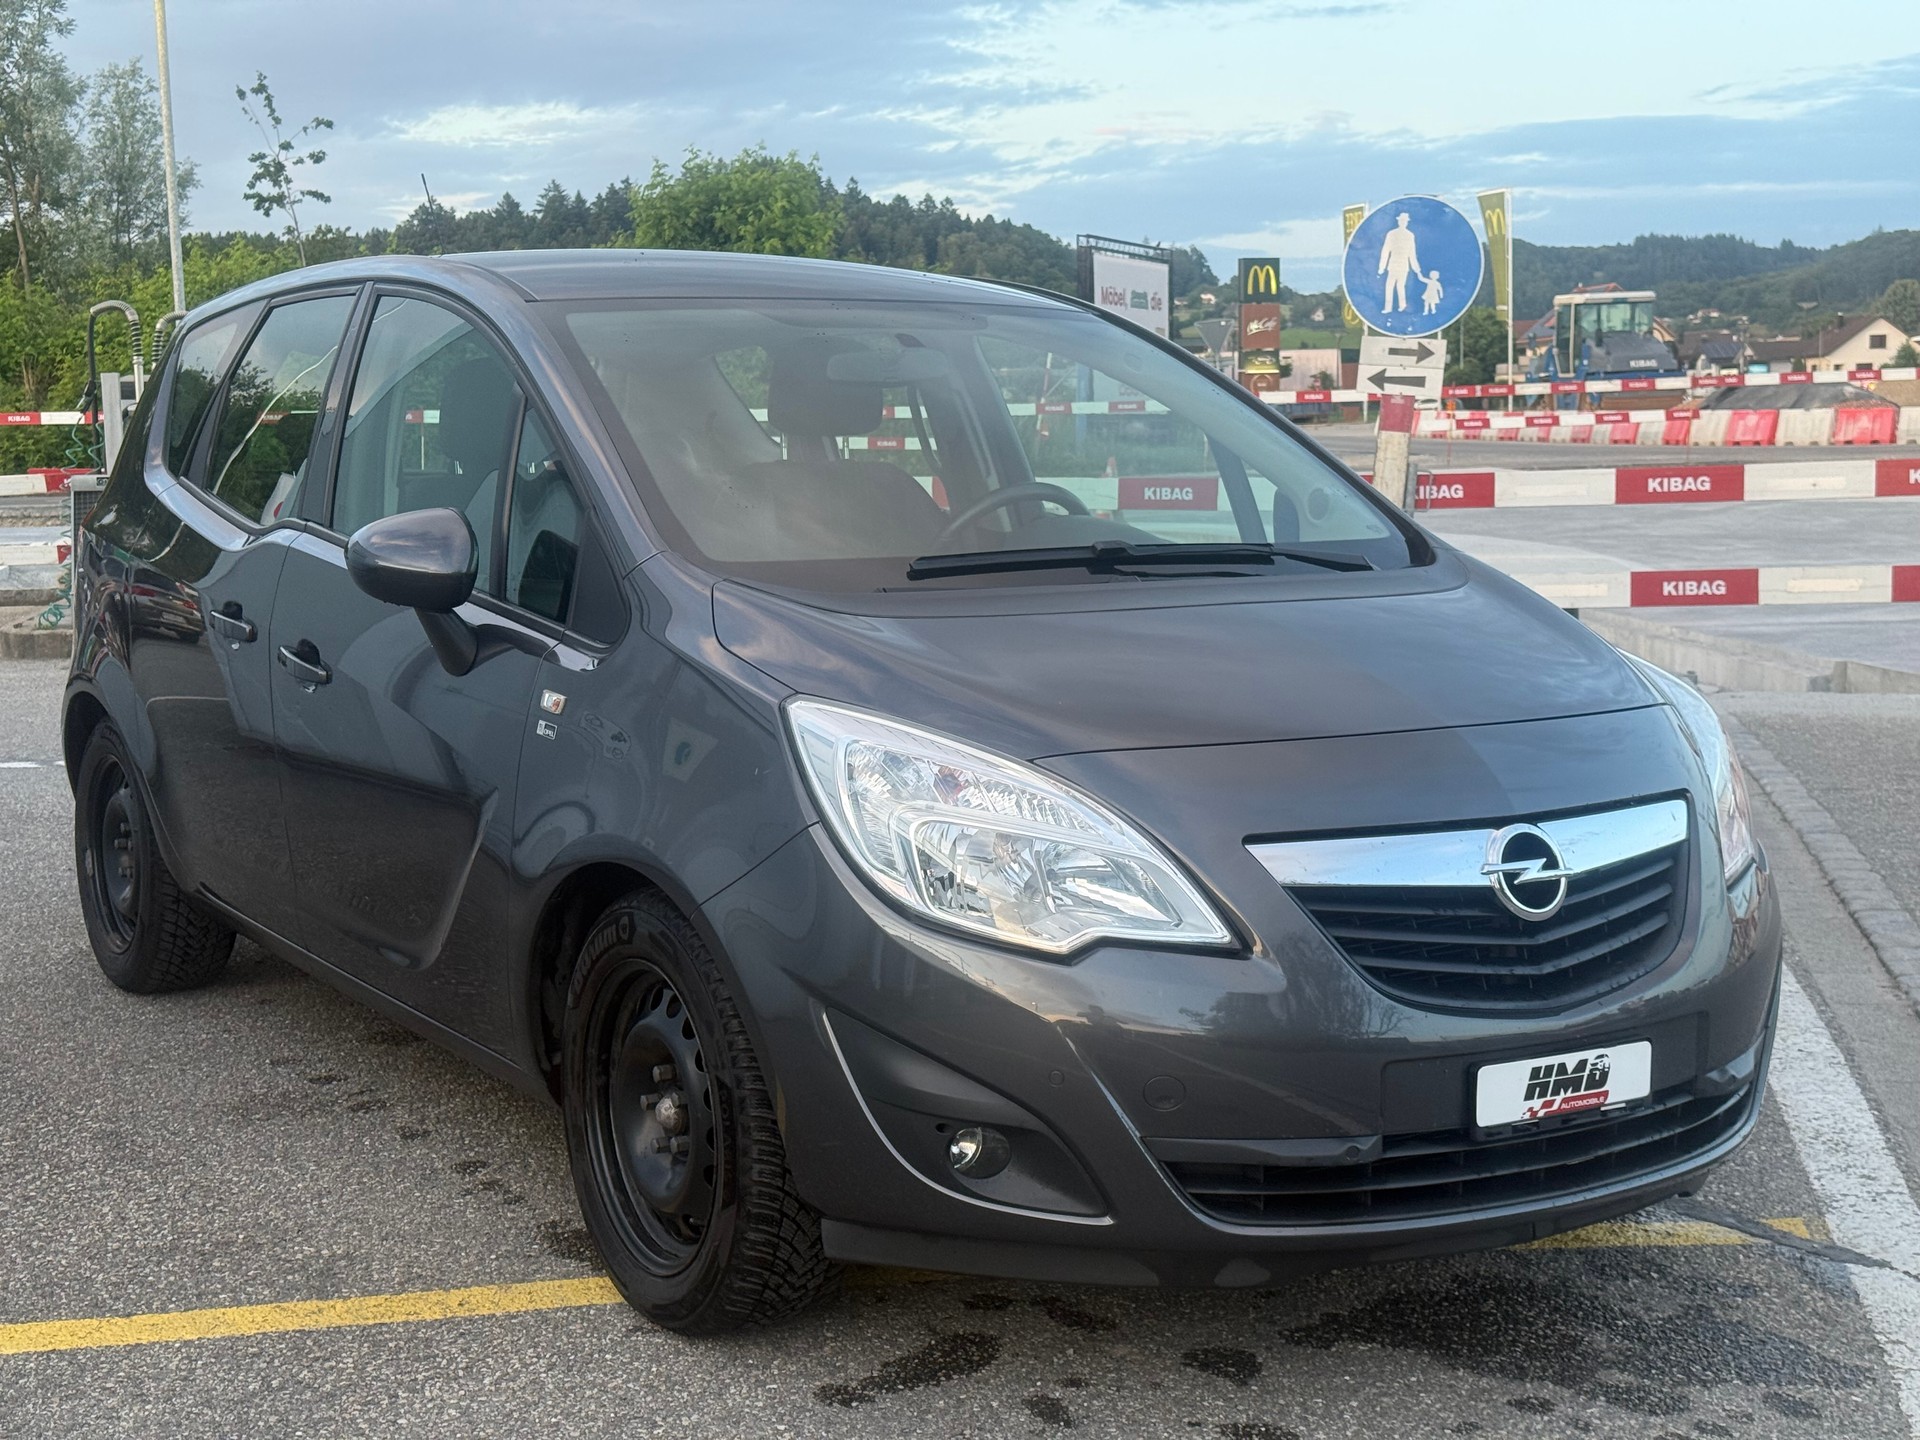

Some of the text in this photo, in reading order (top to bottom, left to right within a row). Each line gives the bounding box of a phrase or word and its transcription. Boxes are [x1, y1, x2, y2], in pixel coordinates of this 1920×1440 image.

[1101, 286, 1162, 311] Möbel, die
[1647, 476, 1711, 493] KIBAG
[1144, 487, 1193, 501] KIBAG
[1662, 580, 1727, 596] KIBAG
[1561, 1096, 1605, 1110] AUTOMOBILE
